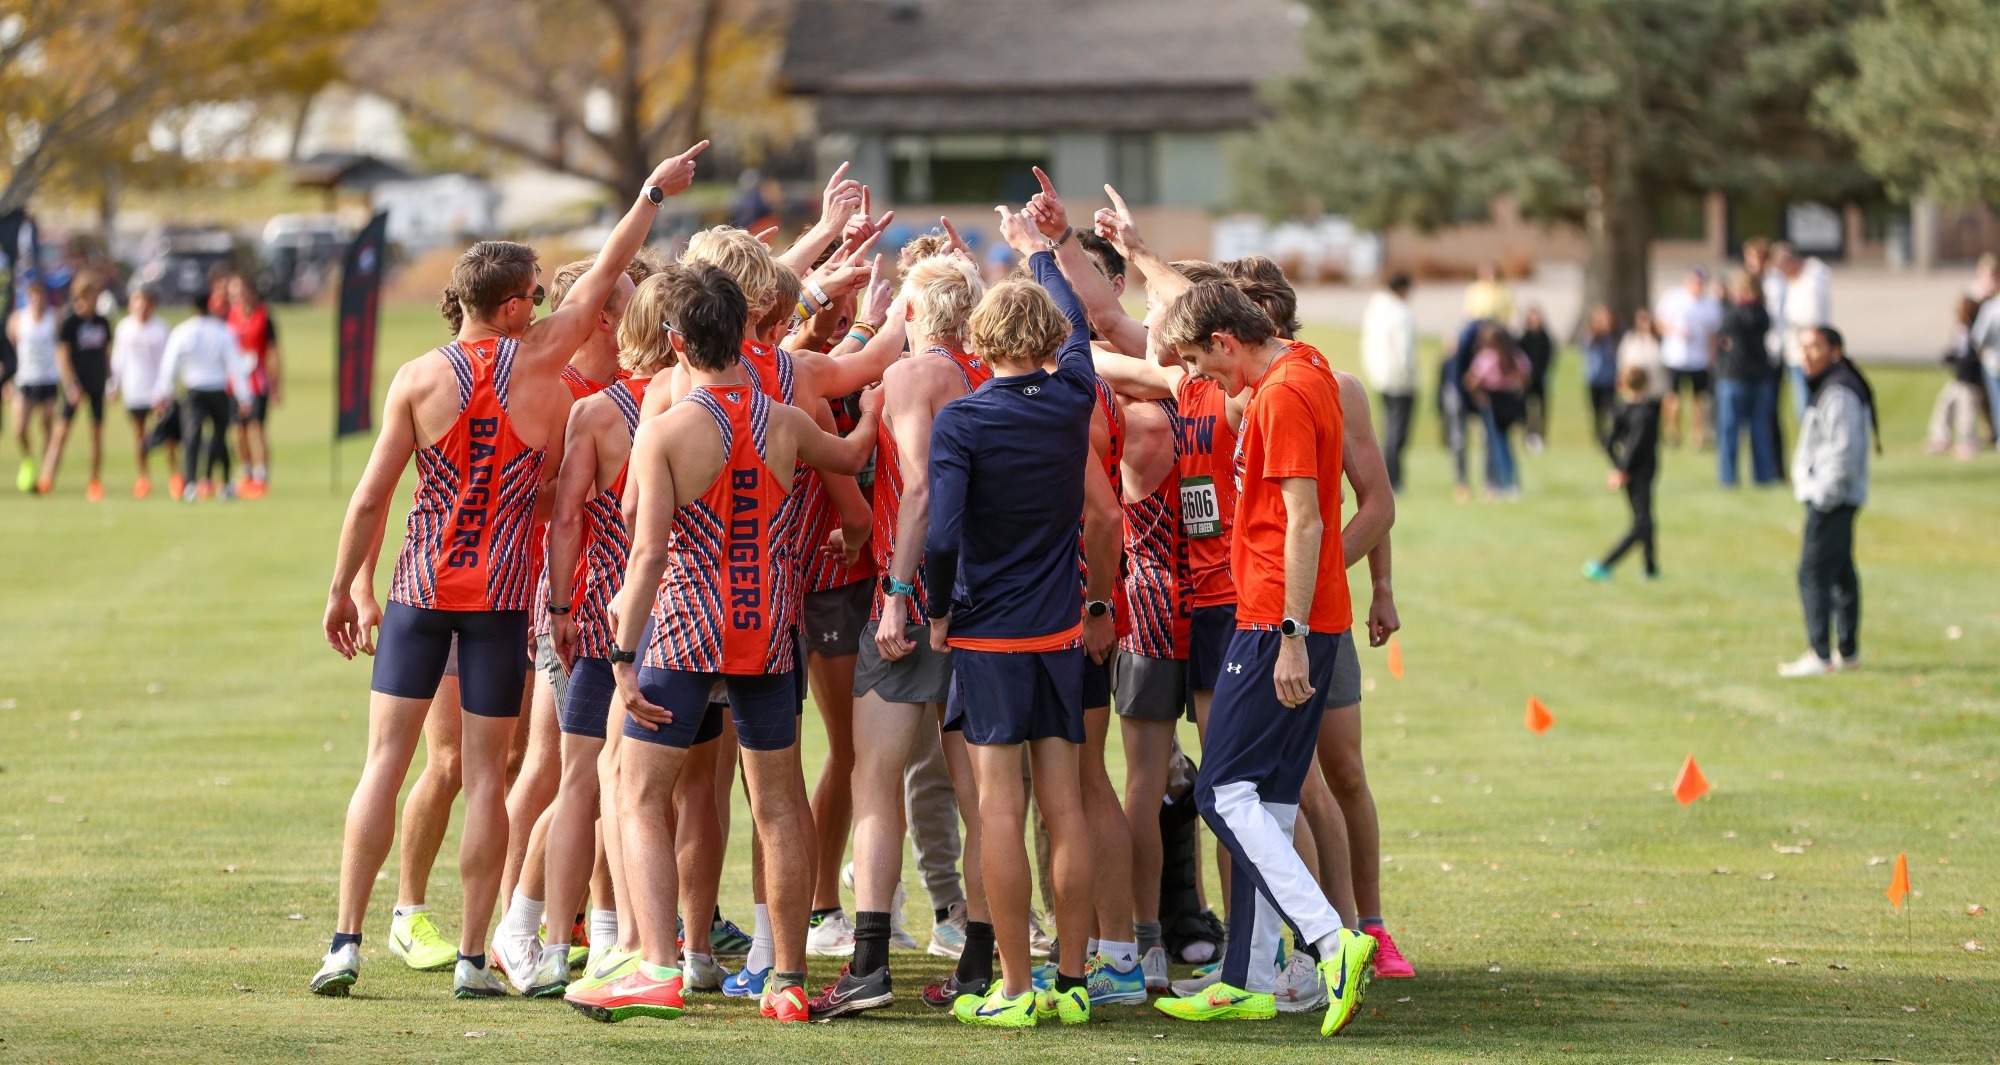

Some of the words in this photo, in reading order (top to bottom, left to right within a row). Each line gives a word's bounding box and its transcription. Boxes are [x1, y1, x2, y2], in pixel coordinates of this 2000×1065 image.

[448, 416, 498, 569] BADGERS
[728, 468, 762, 631] BADGERS
[1182, 489, 1214, 520] 5606
